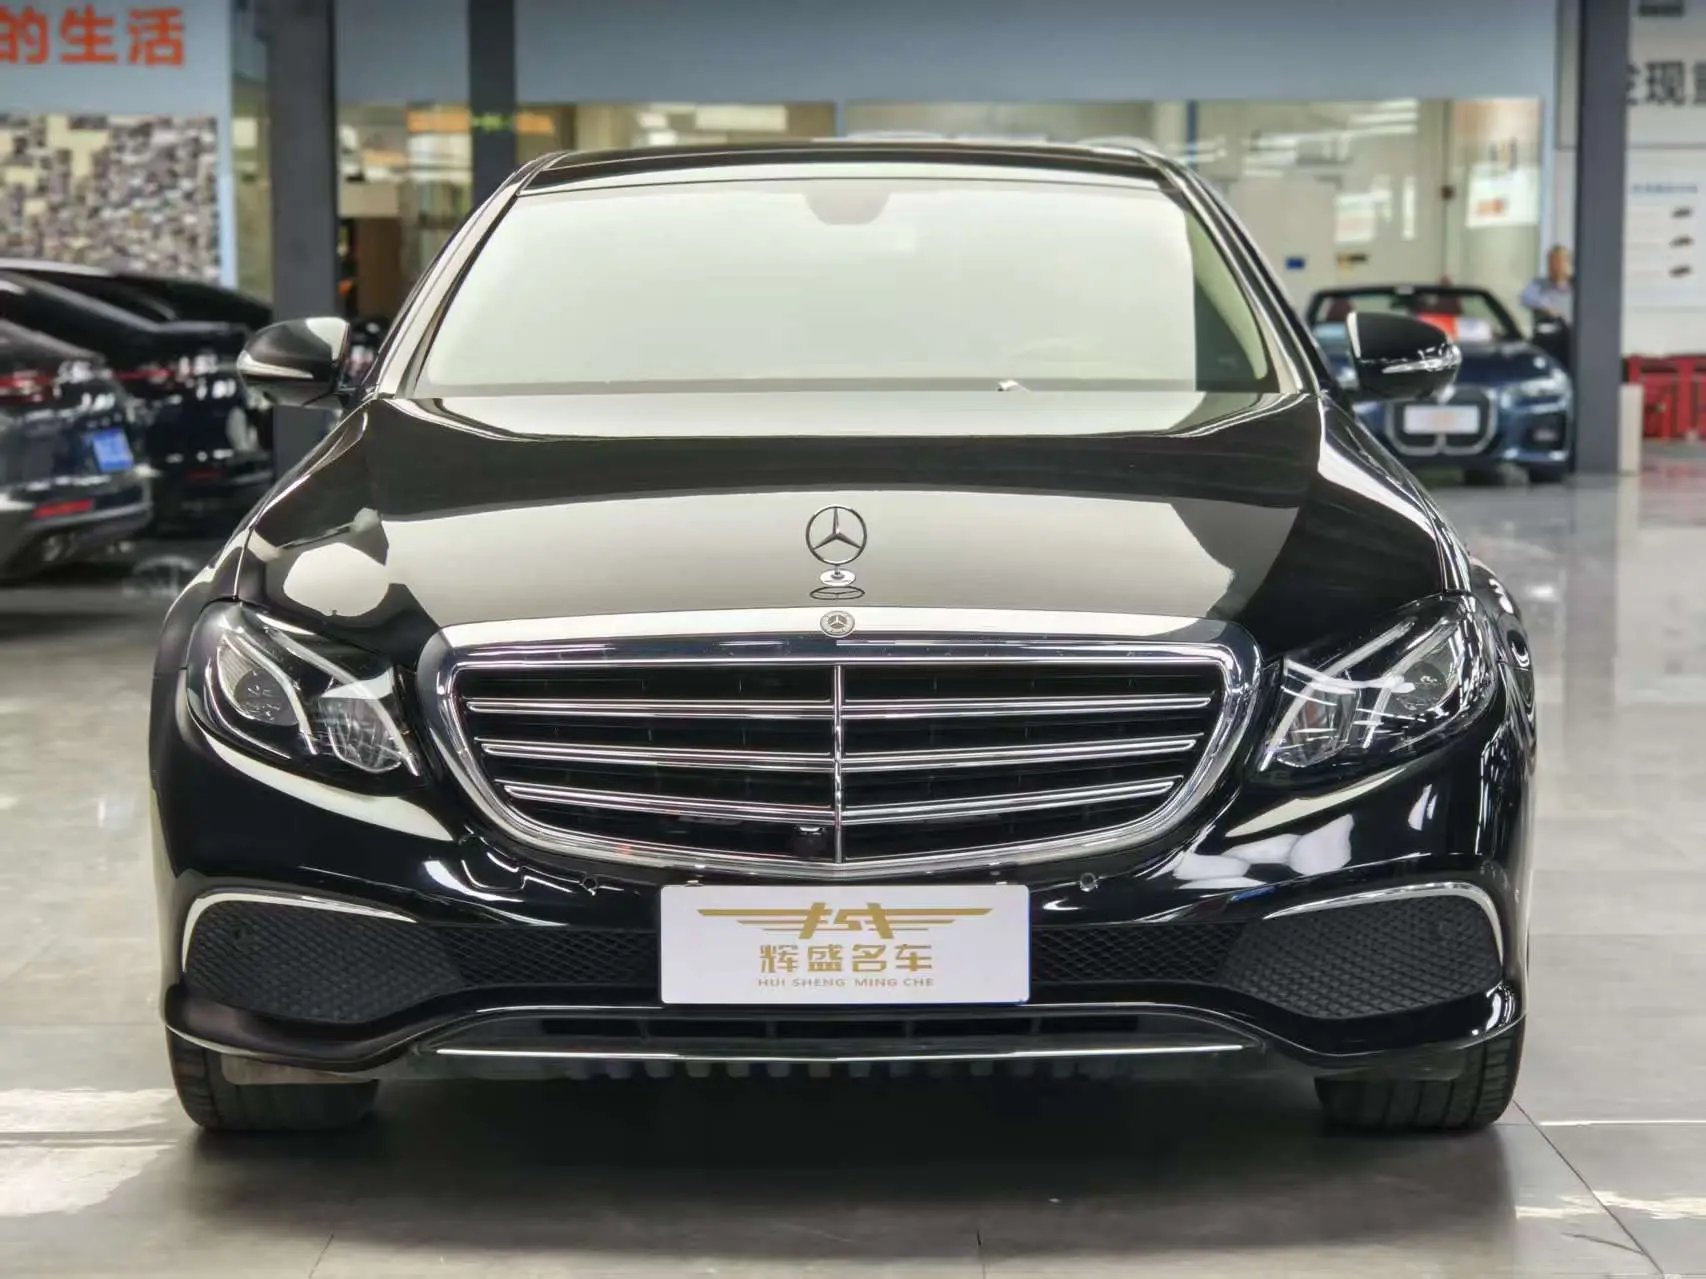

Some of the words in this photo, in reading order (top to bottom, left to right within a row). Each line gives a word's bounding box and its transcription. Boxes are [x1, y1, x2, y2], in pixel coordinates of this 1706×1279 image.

[0, 6, 186, 66] 的生活
[760, 943, 932, 973] 辉盛名车
[758, 978, 786, 987] HUI
[791, 978, 846, 987] SHENG
[854, 978, 898, 987] MING
[903, 978, 934, 987] CHE
